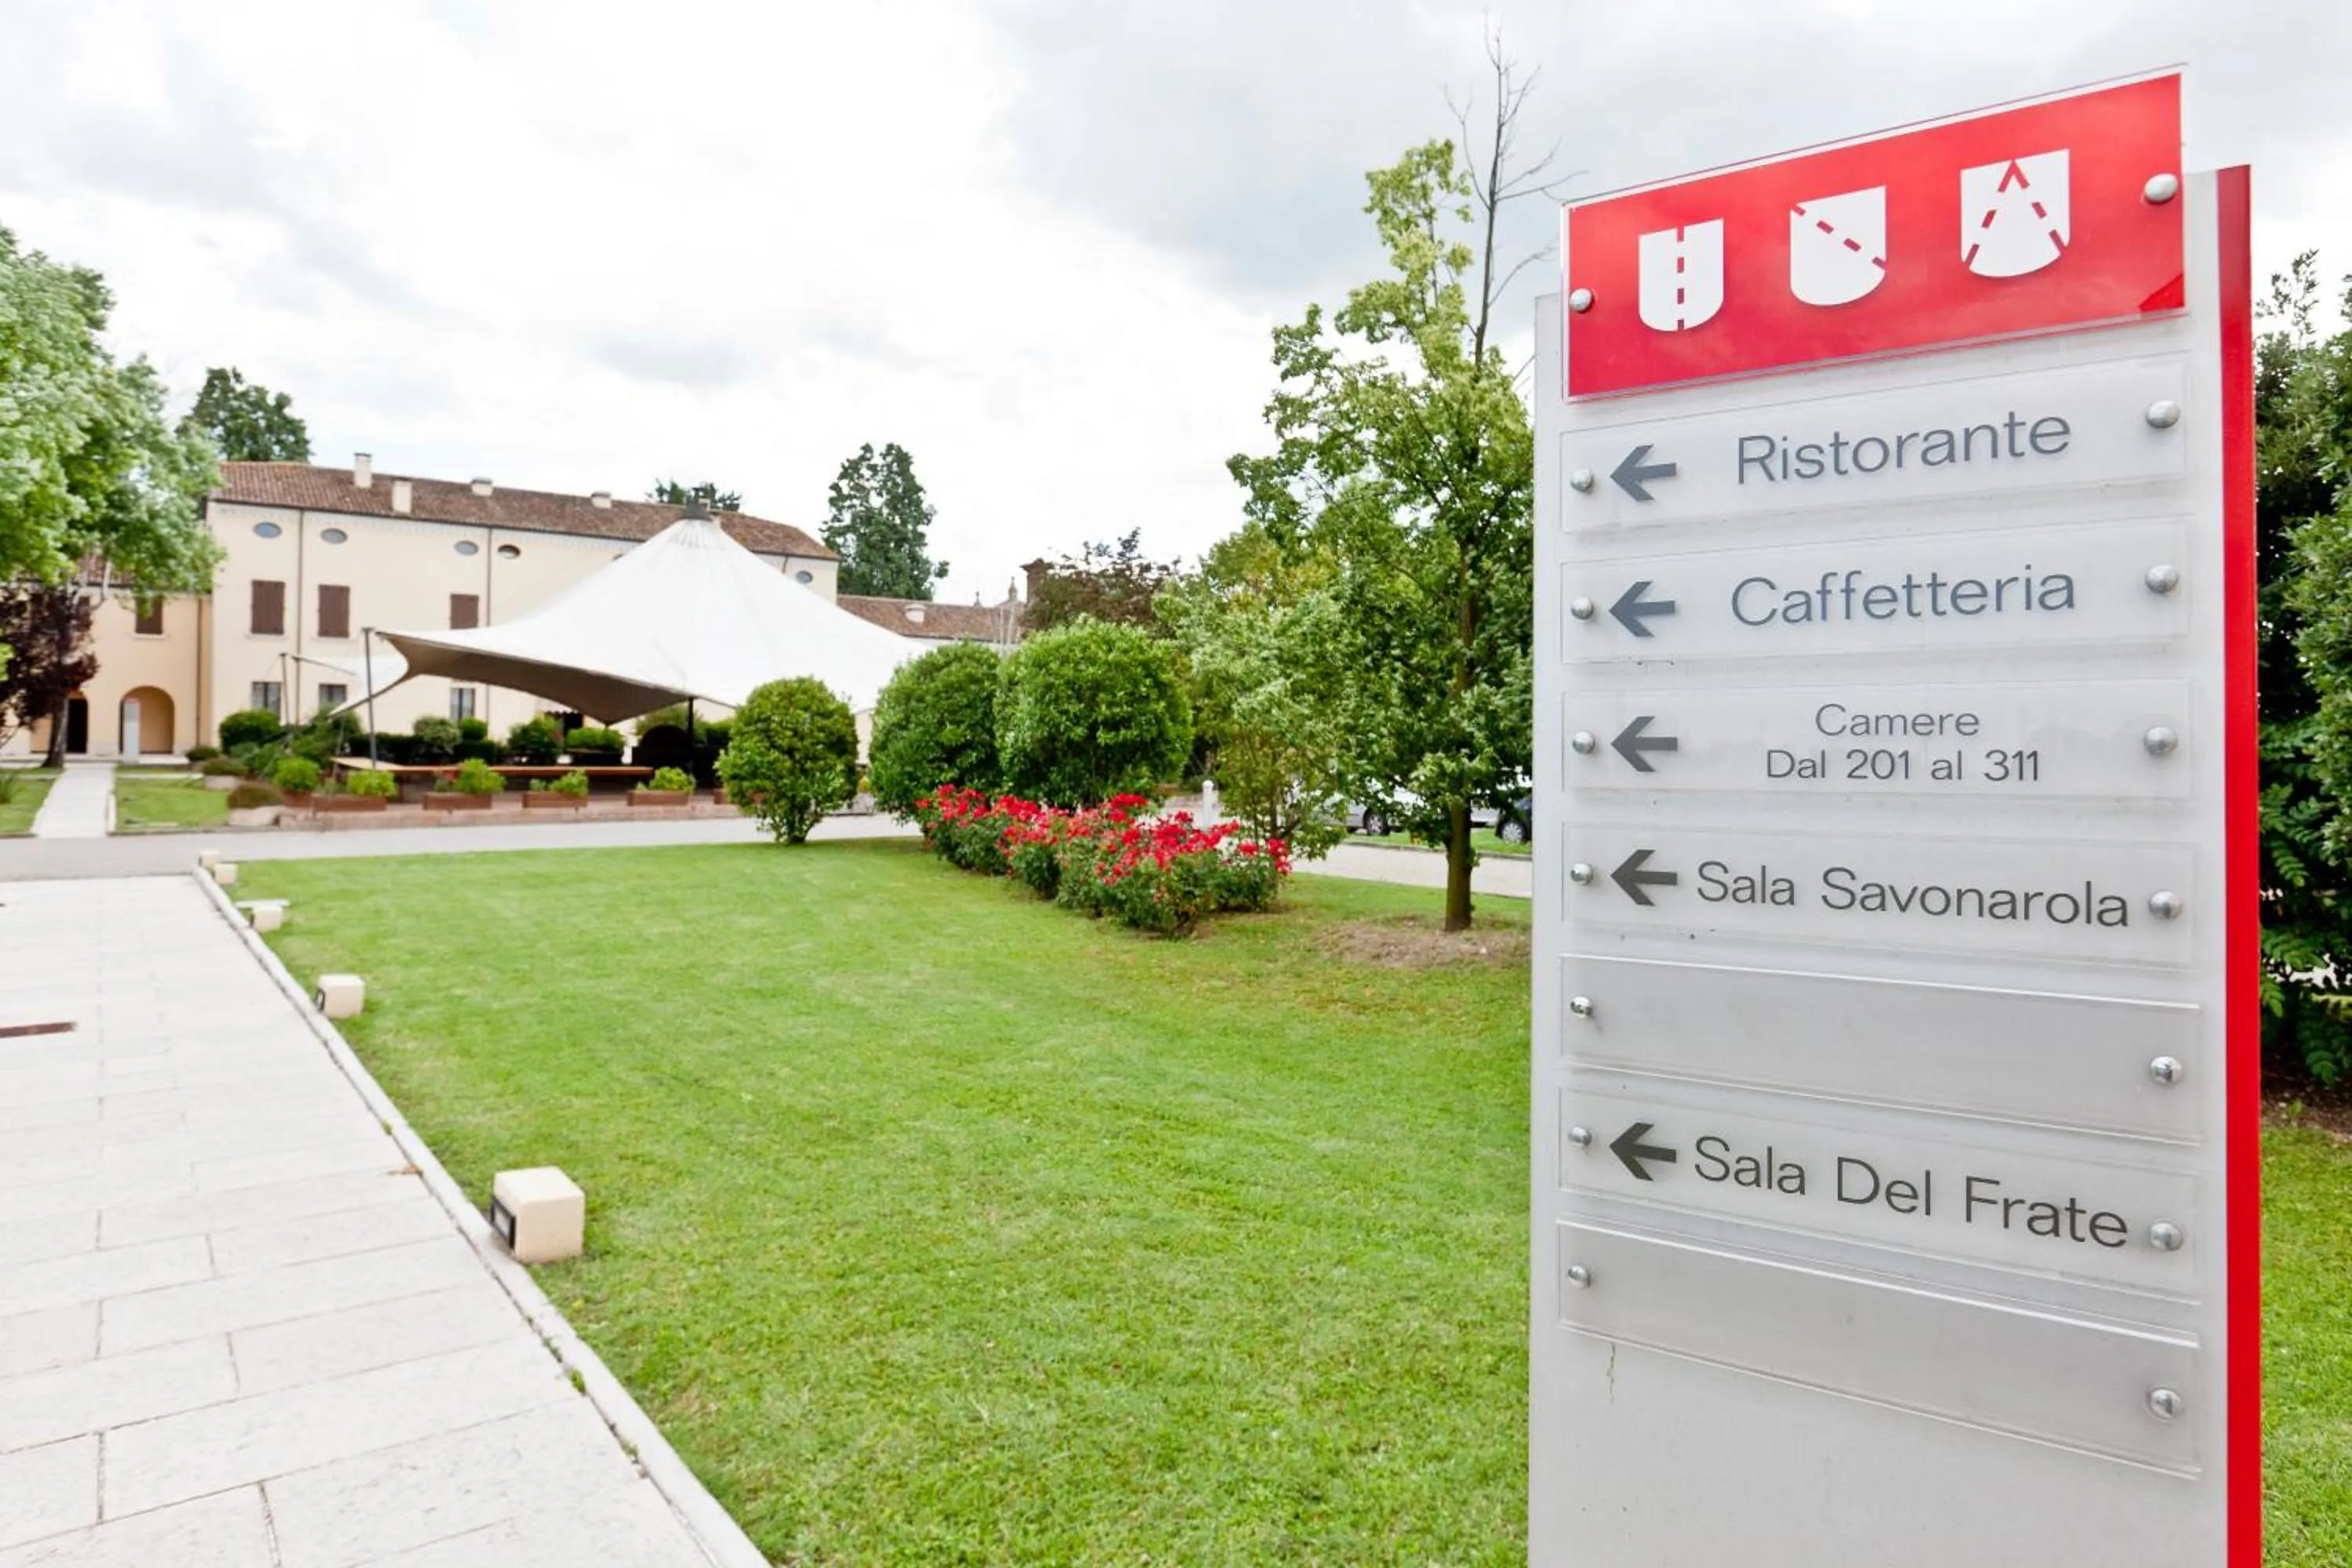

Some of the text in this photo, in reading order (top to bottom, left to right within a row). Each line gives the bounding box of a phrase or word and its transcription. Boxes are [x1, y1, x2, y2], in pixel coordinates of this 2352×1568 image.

[1738, 411, 2071, 484] Ristorante
[1732, 564, 2076, 626] Caffetteria
[1816, 703, 1980, 737] Camere
[1766, 749, 2039, 782] Dal 201 al 311
[1697, 861, 2129, 927] Sala Savonarola
[1694, 1135, 2129, 1248] Sala Del Frate
